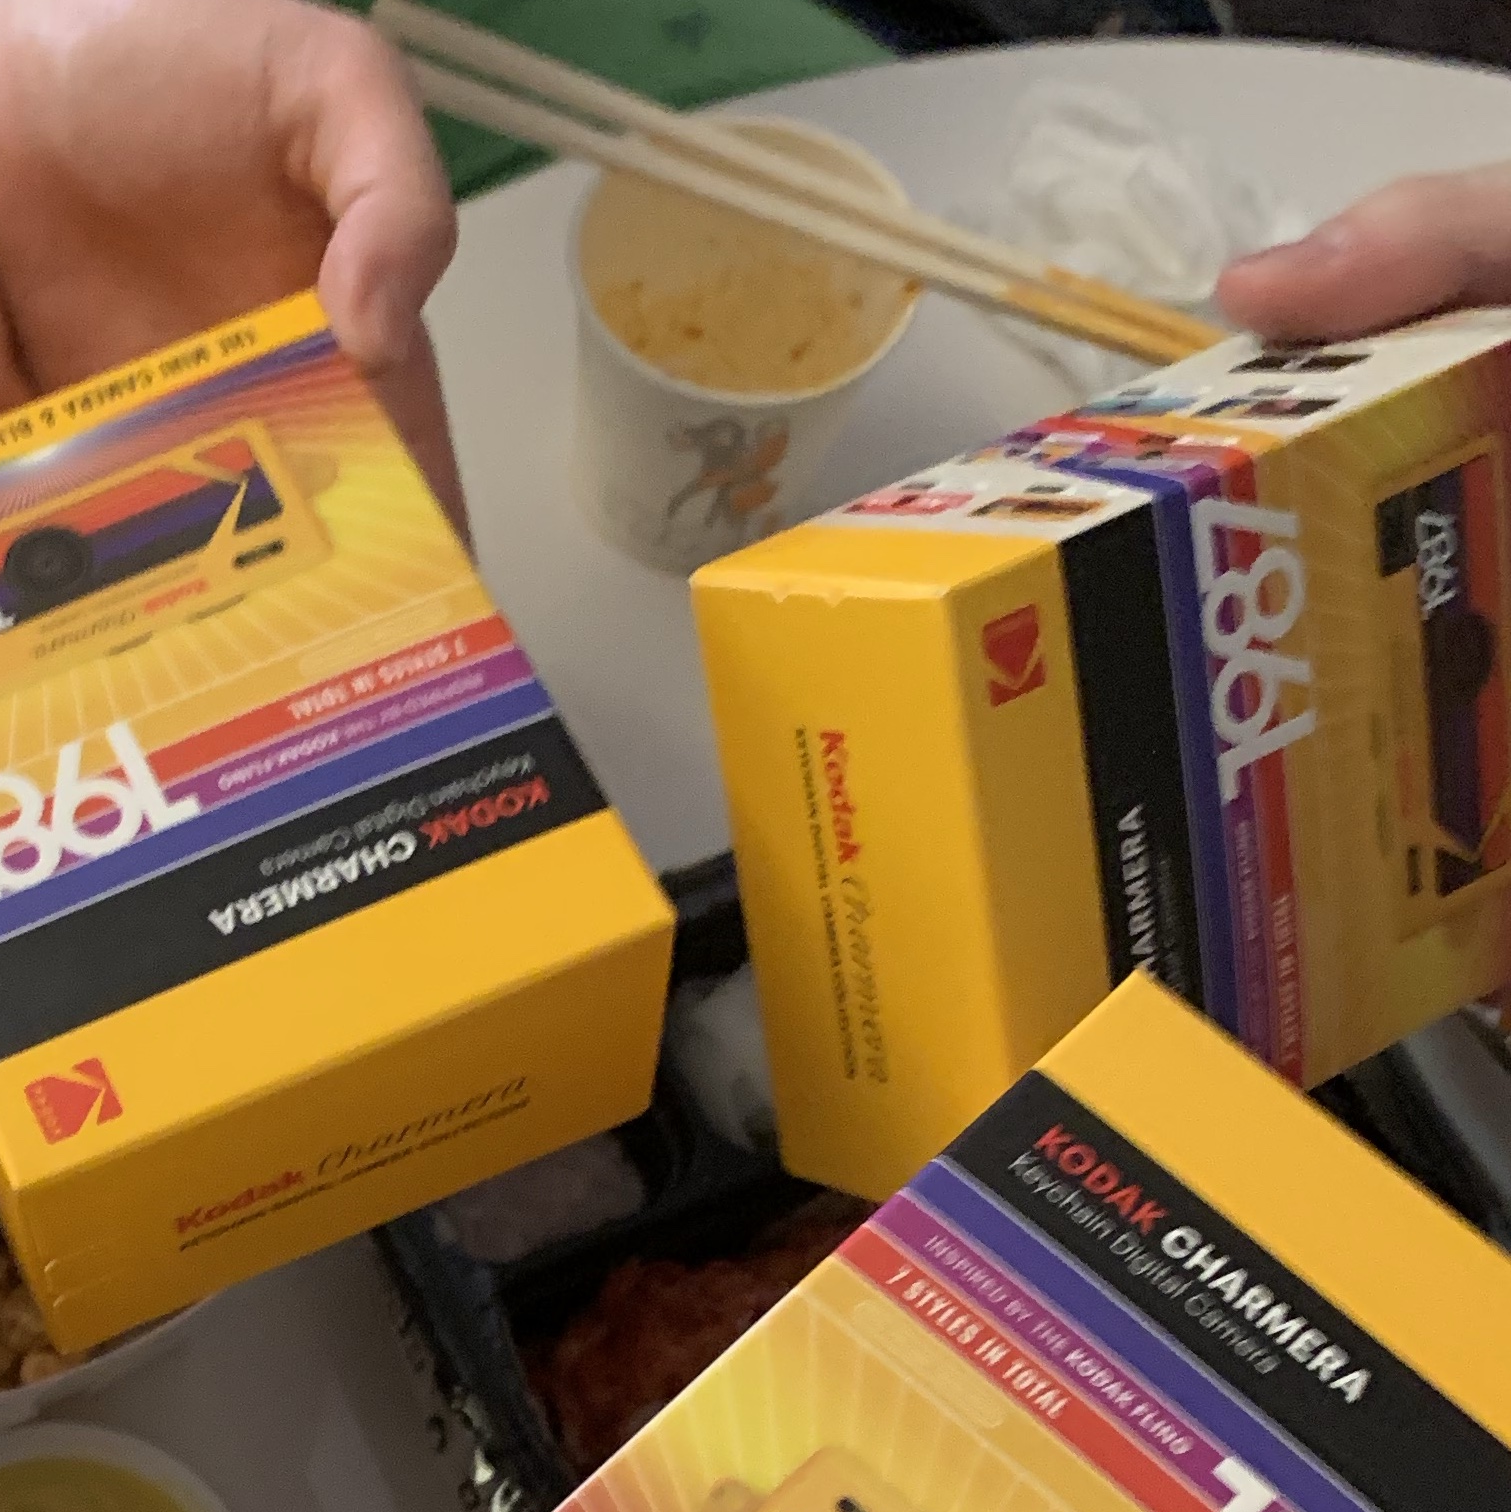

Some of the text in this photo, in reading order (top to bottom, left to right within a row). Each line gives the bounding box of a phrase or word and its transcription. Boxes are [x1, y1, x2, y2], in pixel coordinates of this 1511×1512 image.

[1415, 510, 1459, 620] 1987
[1190, 497, 1317, 805] 1987
[207, 775, 551, 935] KODAK CHARMERA
[885, 1264, 1069, 1420] 7 STYLES IN TOTAL
[1032, 1123, 1372, 1404] KODAK CHARMERA
[1064, 1347, 1136, 1409] KODAK
